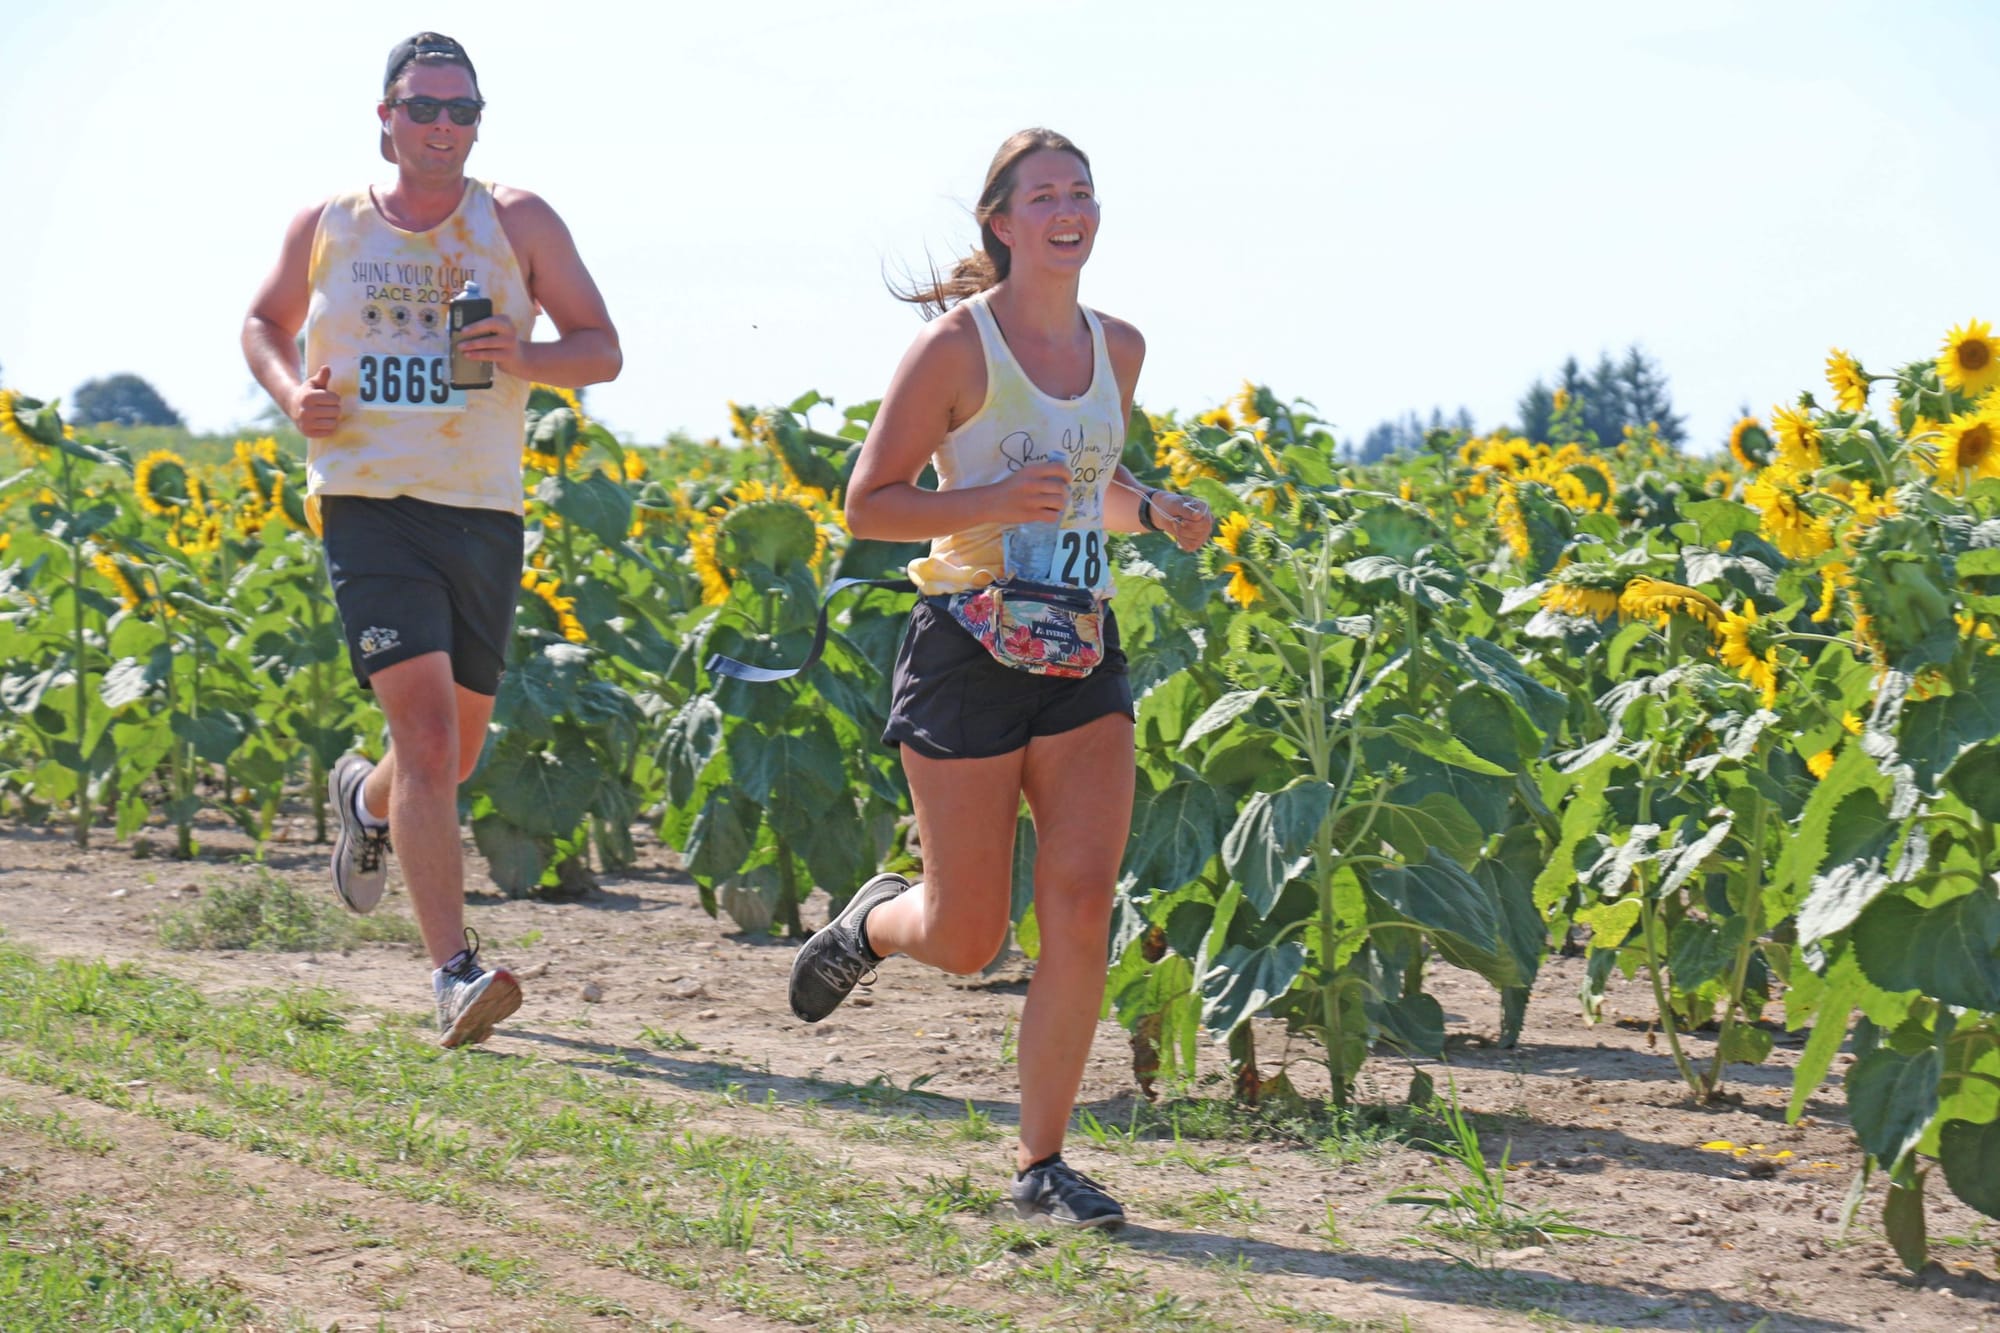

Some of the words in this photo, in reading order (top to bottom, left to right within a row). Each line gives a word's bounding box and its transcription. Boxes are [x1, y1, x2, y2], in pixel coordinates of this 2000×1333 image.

[351, 261, 391, 283] SHINE
[397, 263, 433, 286] YOUR
[438, 267, 477, 289] LIGHT
[366, 285, 412, 302] RACE
[359, 355, 450, 404] 3669
[1000, 430, 1049, 473] Shin
[1062, 423, 1100, 468] Your
